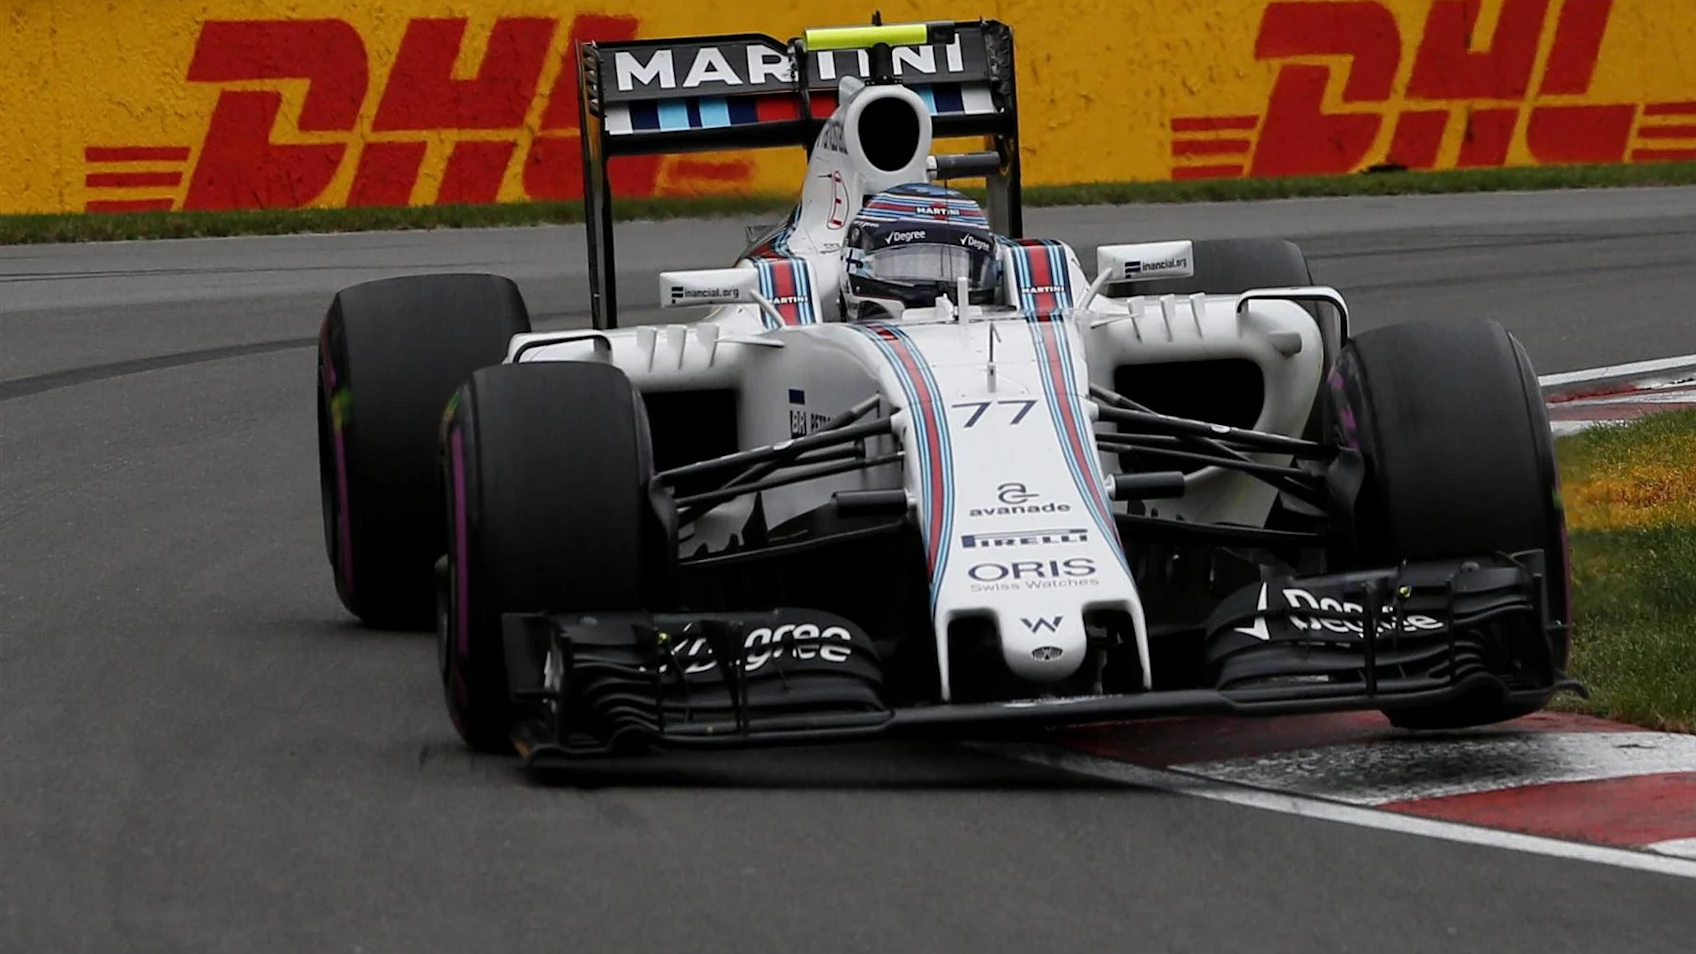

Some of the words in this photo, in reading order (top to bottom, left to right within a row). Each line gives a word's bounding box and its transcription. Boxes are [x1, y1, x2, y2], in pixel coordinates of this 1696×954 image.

[181, 13, 665, 211] DHL
[917, 207, 960, 216] MARTINI
[893, 230, 926, 242] Degree
[952, 399, 1037, 428] 77
[970, 503, 1070, 516] avanade
[961, 529, 1088, 548] PIRELLI
[968, 558, 1096, 582] ORIS
[971, 583, 1019, 592] Swiss
[1025, 579, 1099, 589] Watches
[1283, 589, 1444, 637] Dege
[684, 624, 851, 673] gree
